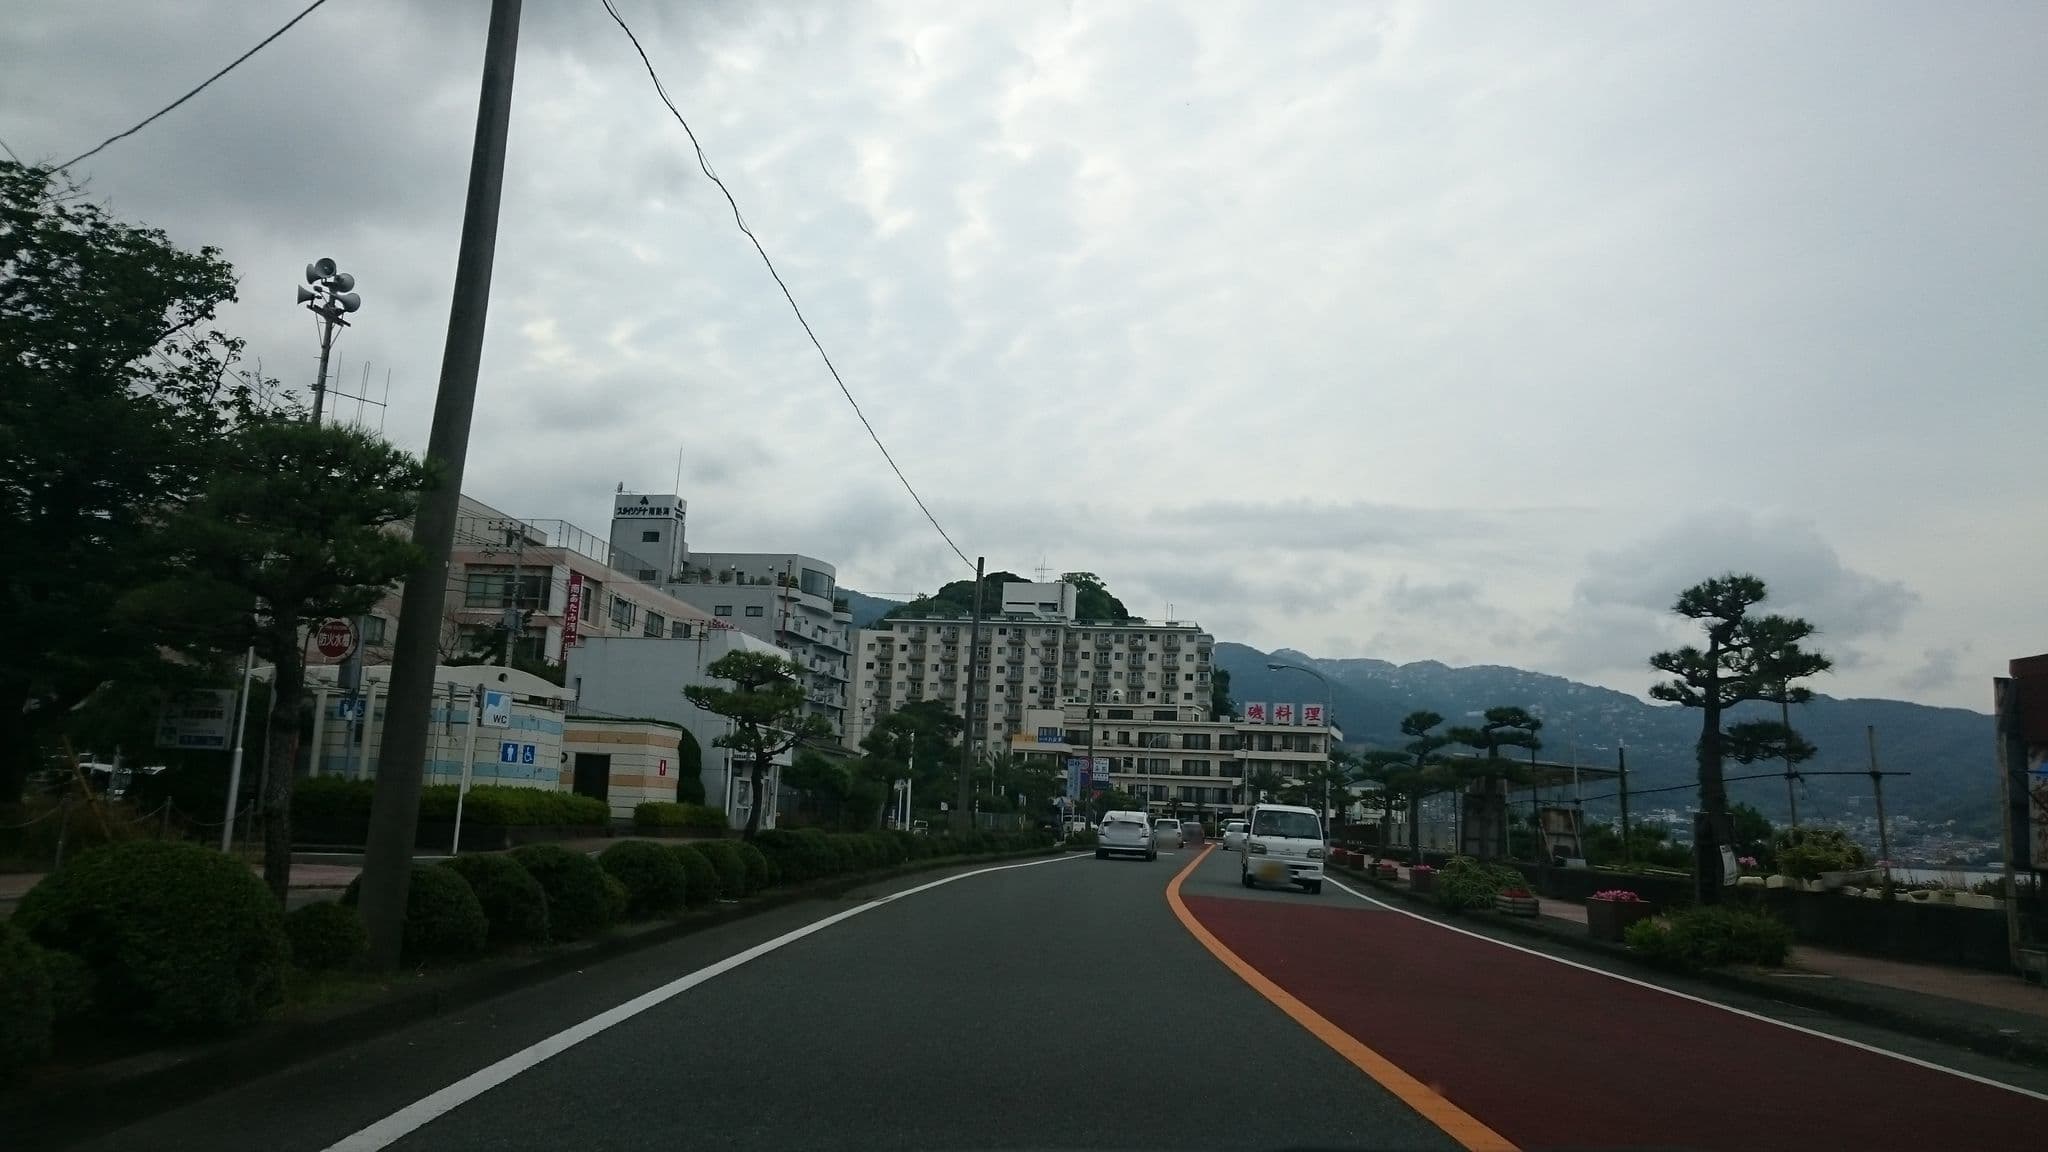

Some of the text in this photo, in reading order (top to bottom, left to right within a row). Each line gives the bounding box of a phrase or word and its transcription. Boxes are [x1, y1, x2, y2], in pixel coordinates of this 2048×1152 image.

[493, 713, 508, 725] WC
[1247, 704, 1322, 722] 磯料理
